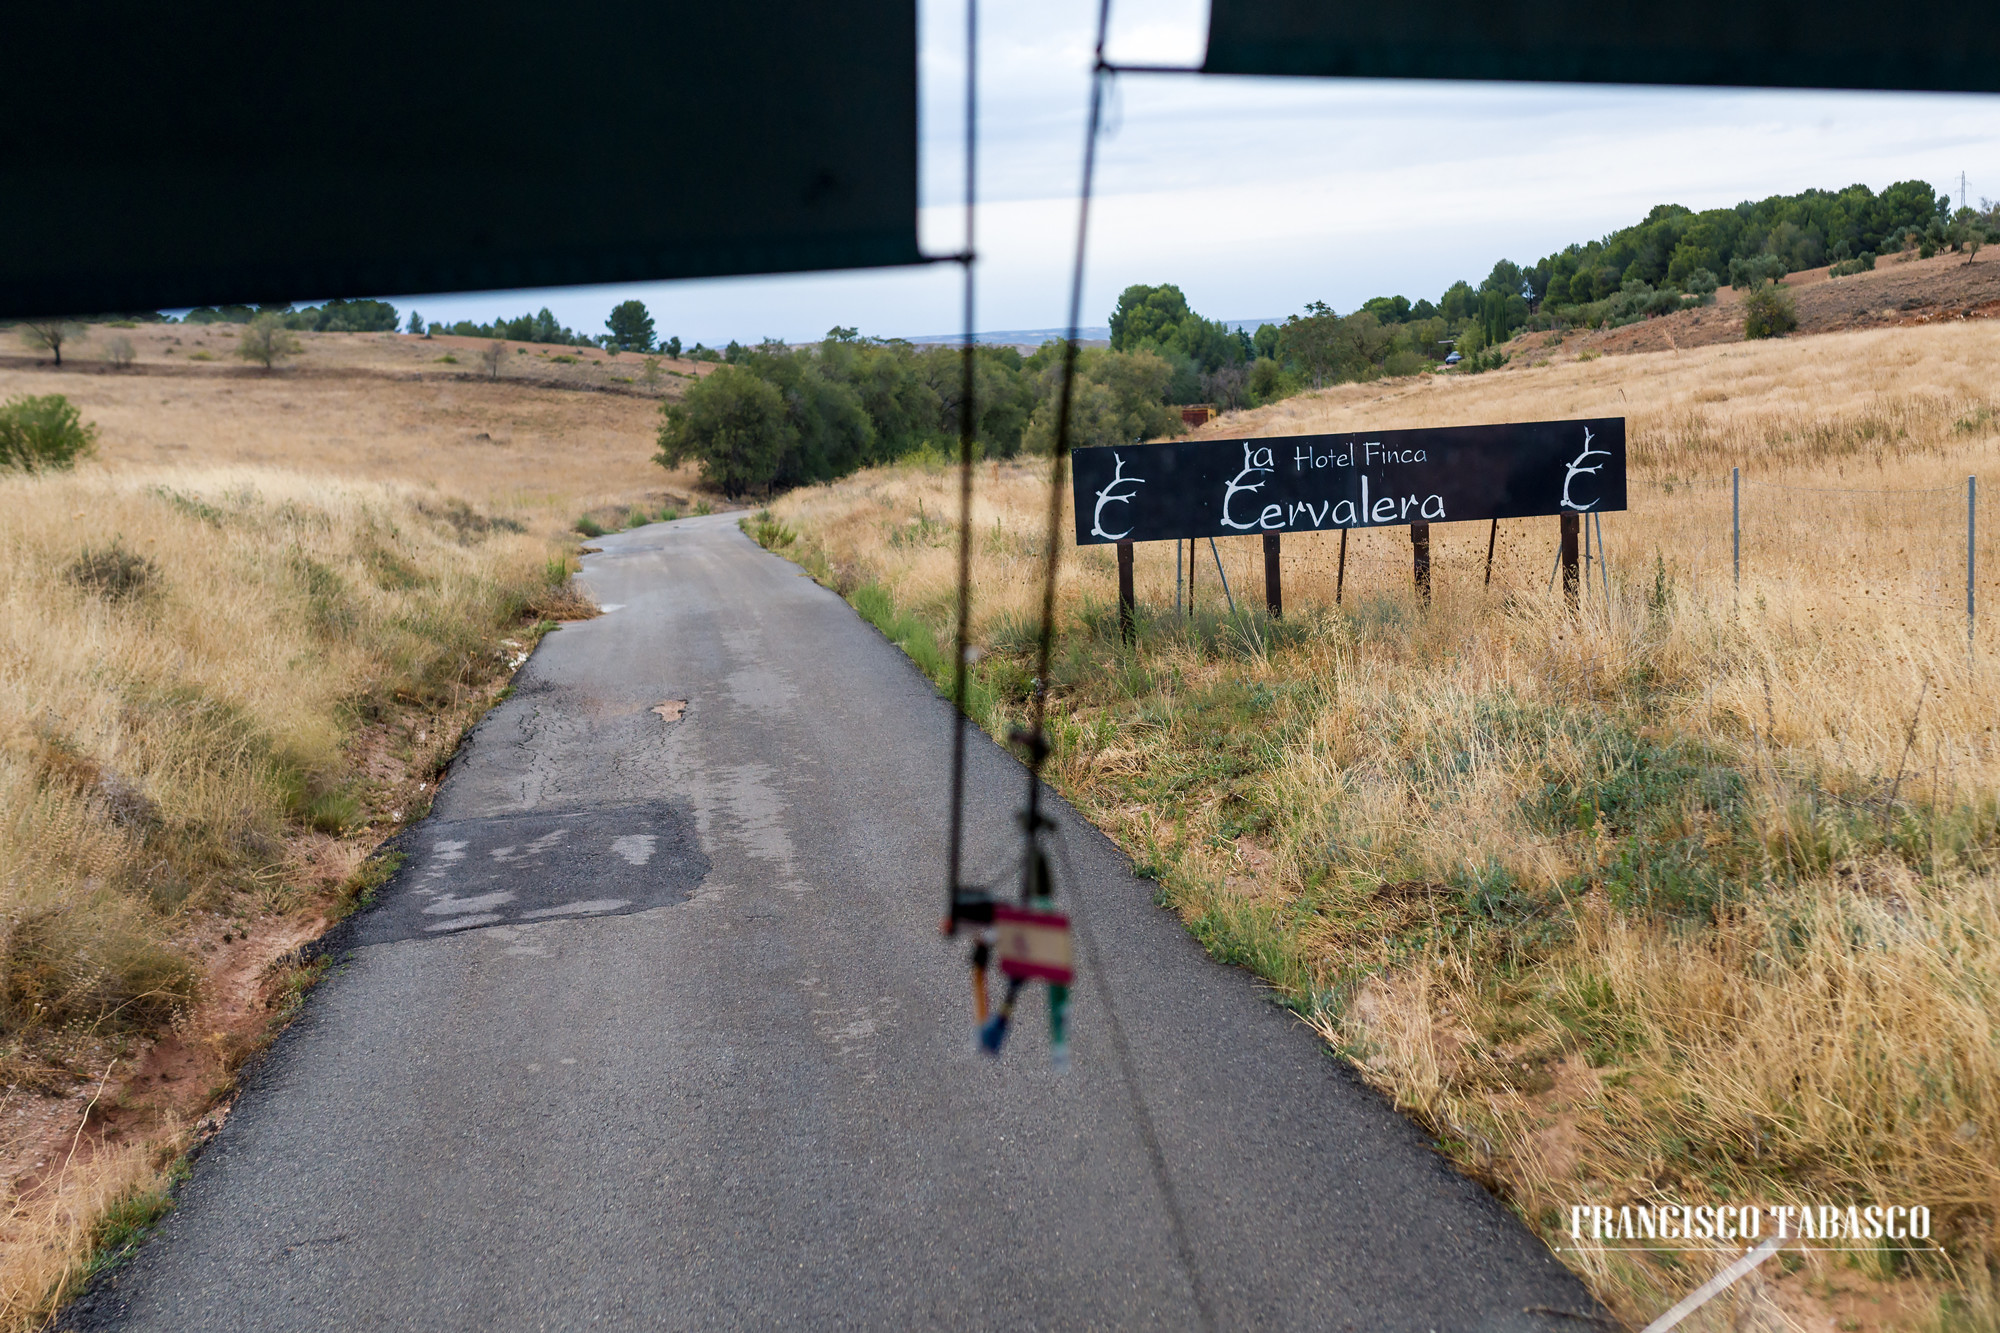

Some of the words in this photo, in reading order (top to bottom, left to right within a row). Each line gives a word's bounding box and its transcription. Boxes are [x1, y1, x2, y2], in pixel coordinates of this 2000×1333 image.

[1293, 442, 1354, 471] Hotel
[1363, 441, 1427, 466] Finca
[1220, 467, 1446, 530] Cervalera
